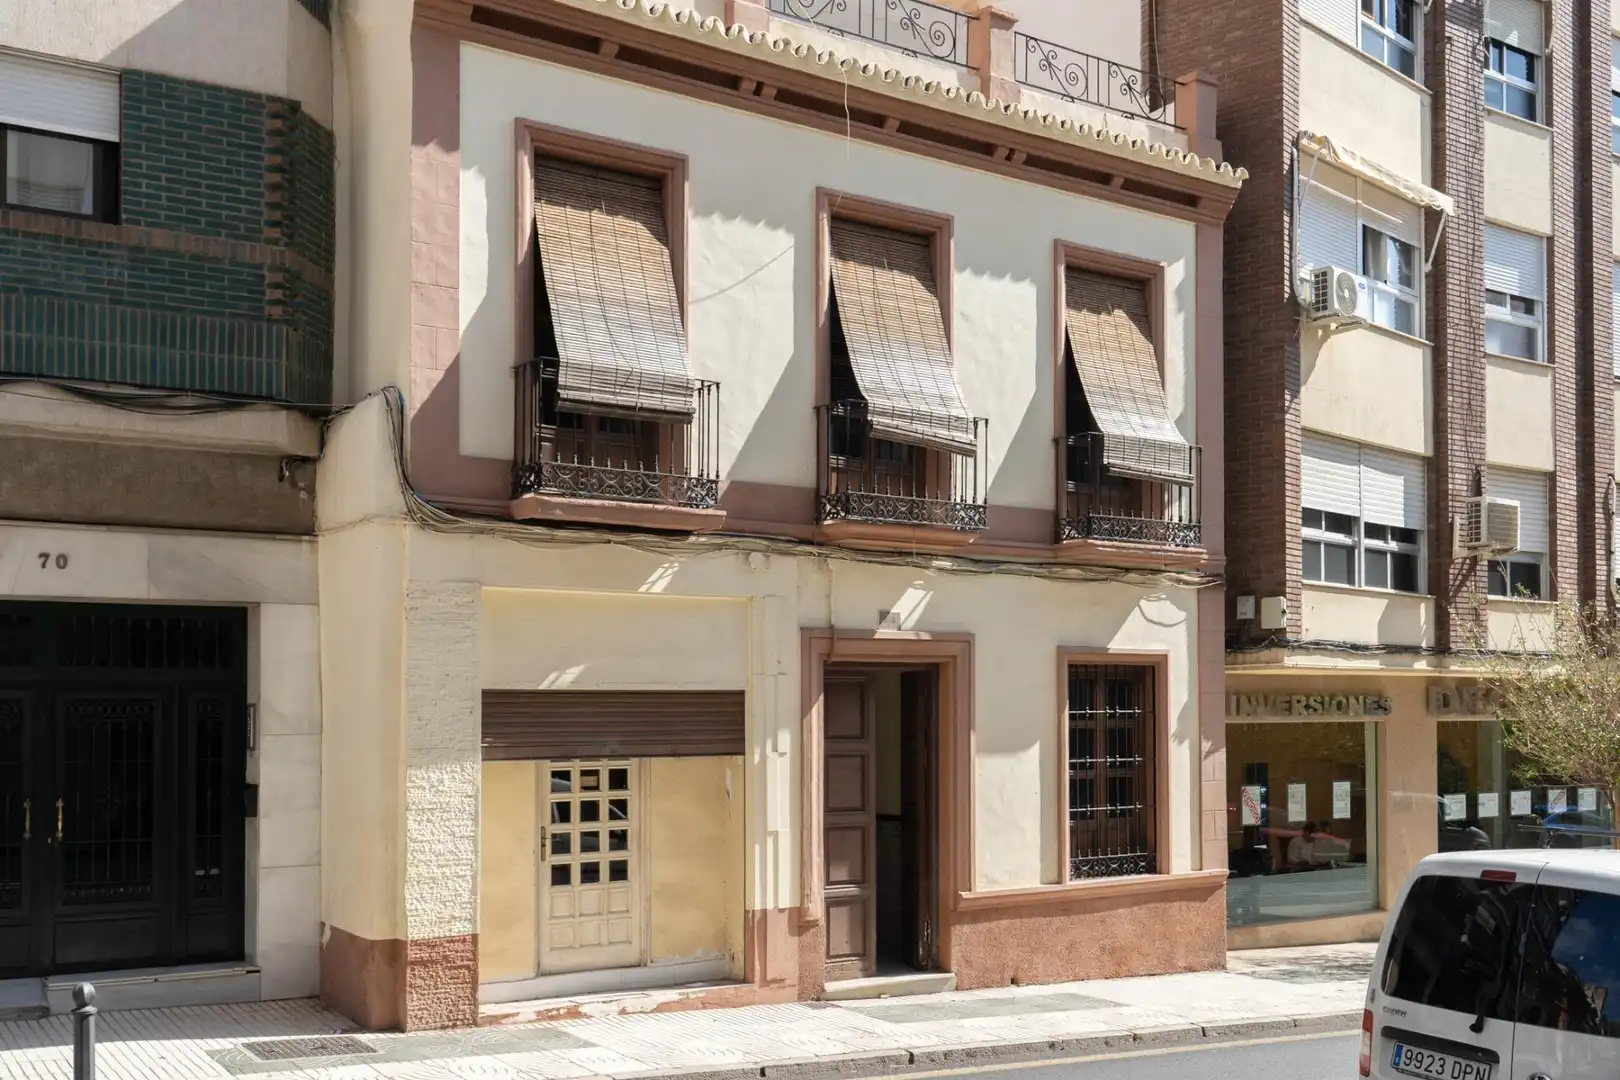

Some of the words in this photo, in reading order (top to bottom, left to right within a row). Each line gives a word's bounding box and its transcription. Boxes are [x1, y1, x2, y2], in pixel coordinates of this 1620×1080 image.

[38, 552, 68, 570] 70
[1230, 694, 1392, 716] INVERSIONES
[1403, 1049, 1446, 1075] 9923
[1451, 1060, 1487, 1080] DPN
